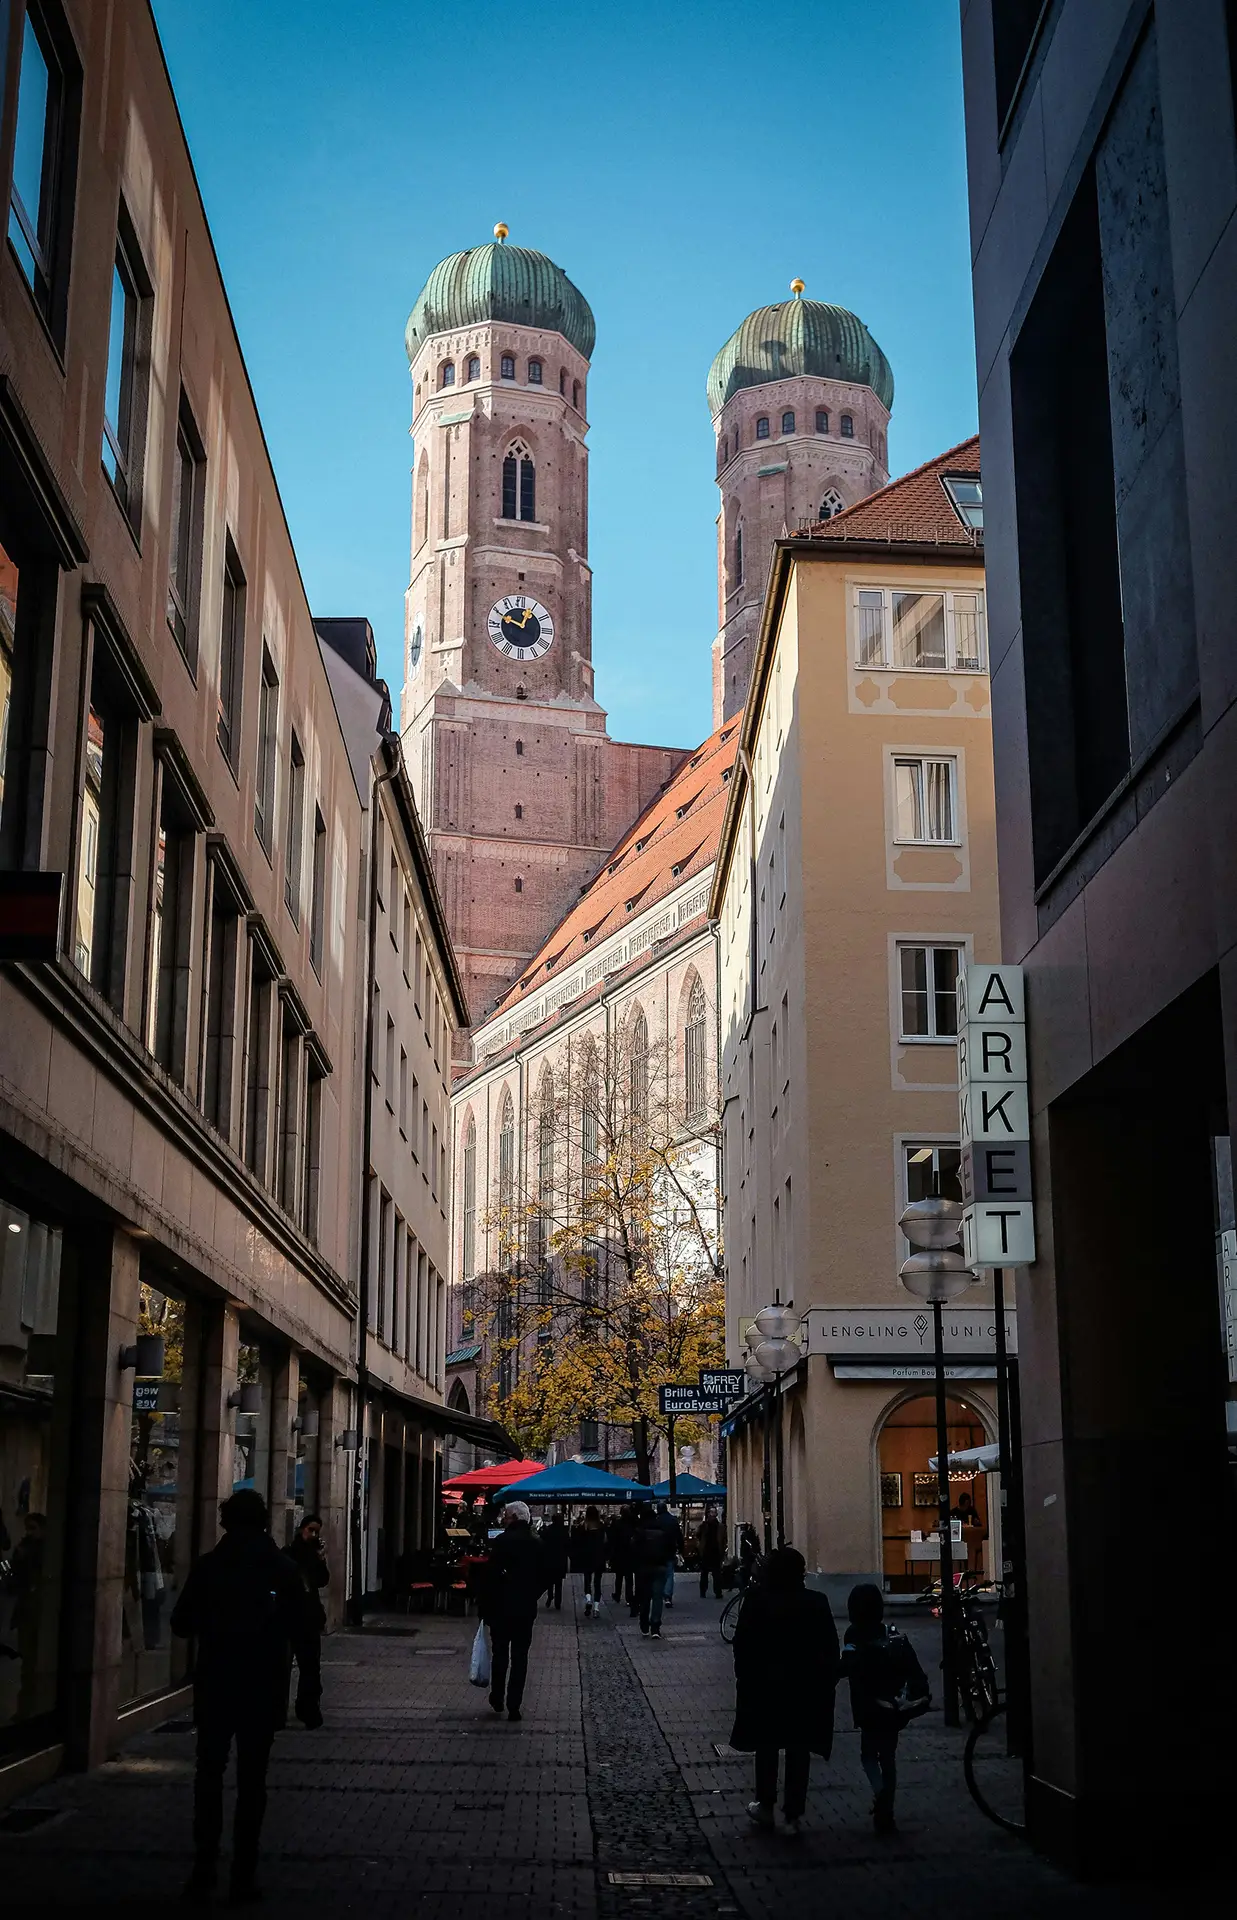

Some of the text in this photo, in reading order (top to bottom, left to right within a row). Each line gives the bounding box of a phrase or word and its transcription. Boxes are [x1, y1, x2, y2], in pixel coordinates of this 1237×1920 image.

[958, 977, 974, 1258] ARKET
[977, 972, 1022, 1255] ARKET
[1223, 1235, 1235, 1377] ARKET
[822, 1326, 908, 1337] LENGLING
[892, 1367, 955, 1376] Parfum Bouue
[714, 1375, 742, 1384] FREY
[664, 1388, 693, 1398] Brille
[703, 1384, 740, 1394] WILLE
[664, 1399, 723, 1411] EuroEyes!
